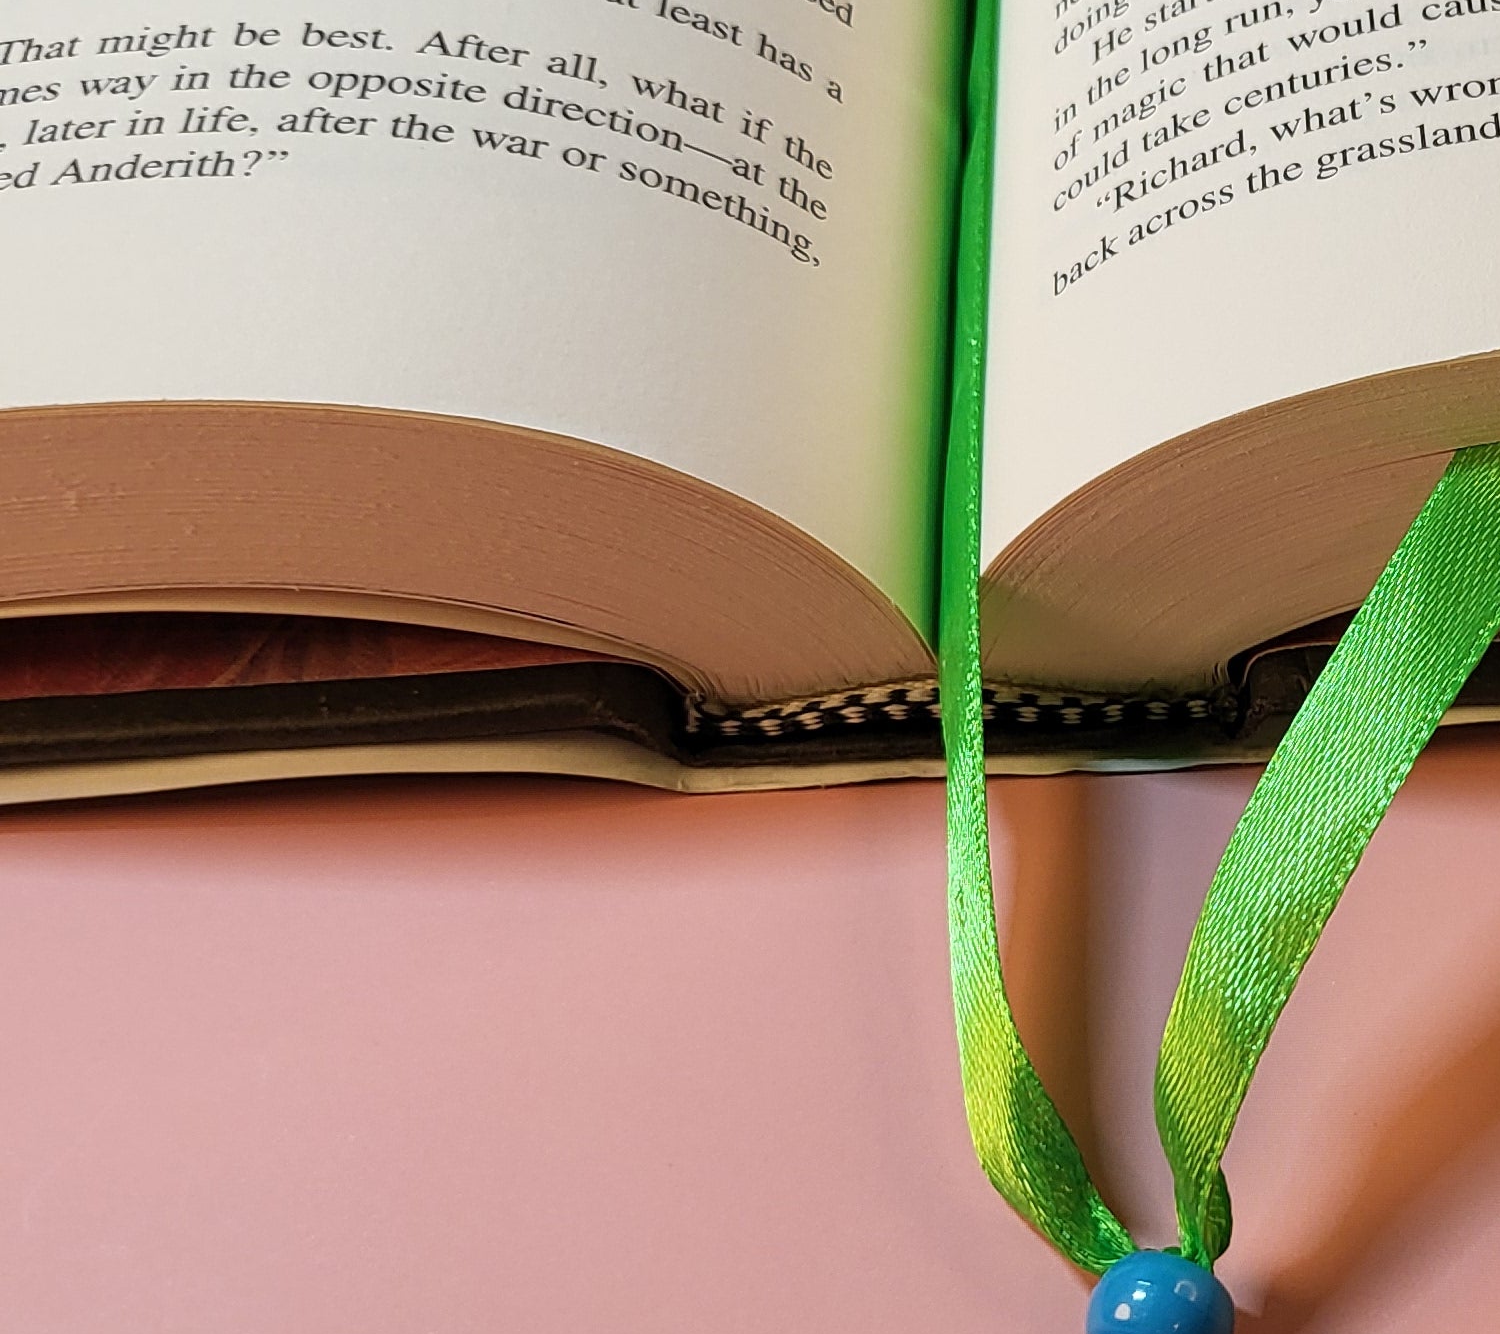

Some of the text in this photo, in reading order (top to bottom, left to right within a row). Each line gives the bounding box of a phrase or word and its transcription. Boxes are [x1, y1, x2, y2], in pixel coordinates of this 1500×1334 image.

[0, 21, 833, 181] That might be best. After all, what if the
[755, 31, 813, 83] has
[825, 79, 844, 105] a
[1053, 129, 1083, 172] of
[1092, 77, 1187, 144] magic
[1202, 41, 1271, 83] that
[1286, 2, 1404, 53] would
[1054, 102, 1077, 135] in
[1086, 66, 1131, 106] the
[1140, 25, 1213, 75] long
[1224, 0, 1295, 36] run,
[1092, 26, 1133, 66] He
[79, 74, 160, 102] way
[169, 64, 211, 92] in
[228, 62, 292, 90] the
[306, 70, 488, 104] opposite
[777, 176, 828, 221] the
[1268, 91, 1397, 143] what’s
[21, 105, 821, 268] later in life, after the war or something,
[1052, 234, 1120, 297] back
[1128, 183, 1235, 247] across
[1245, 161, 1304, 195] the
